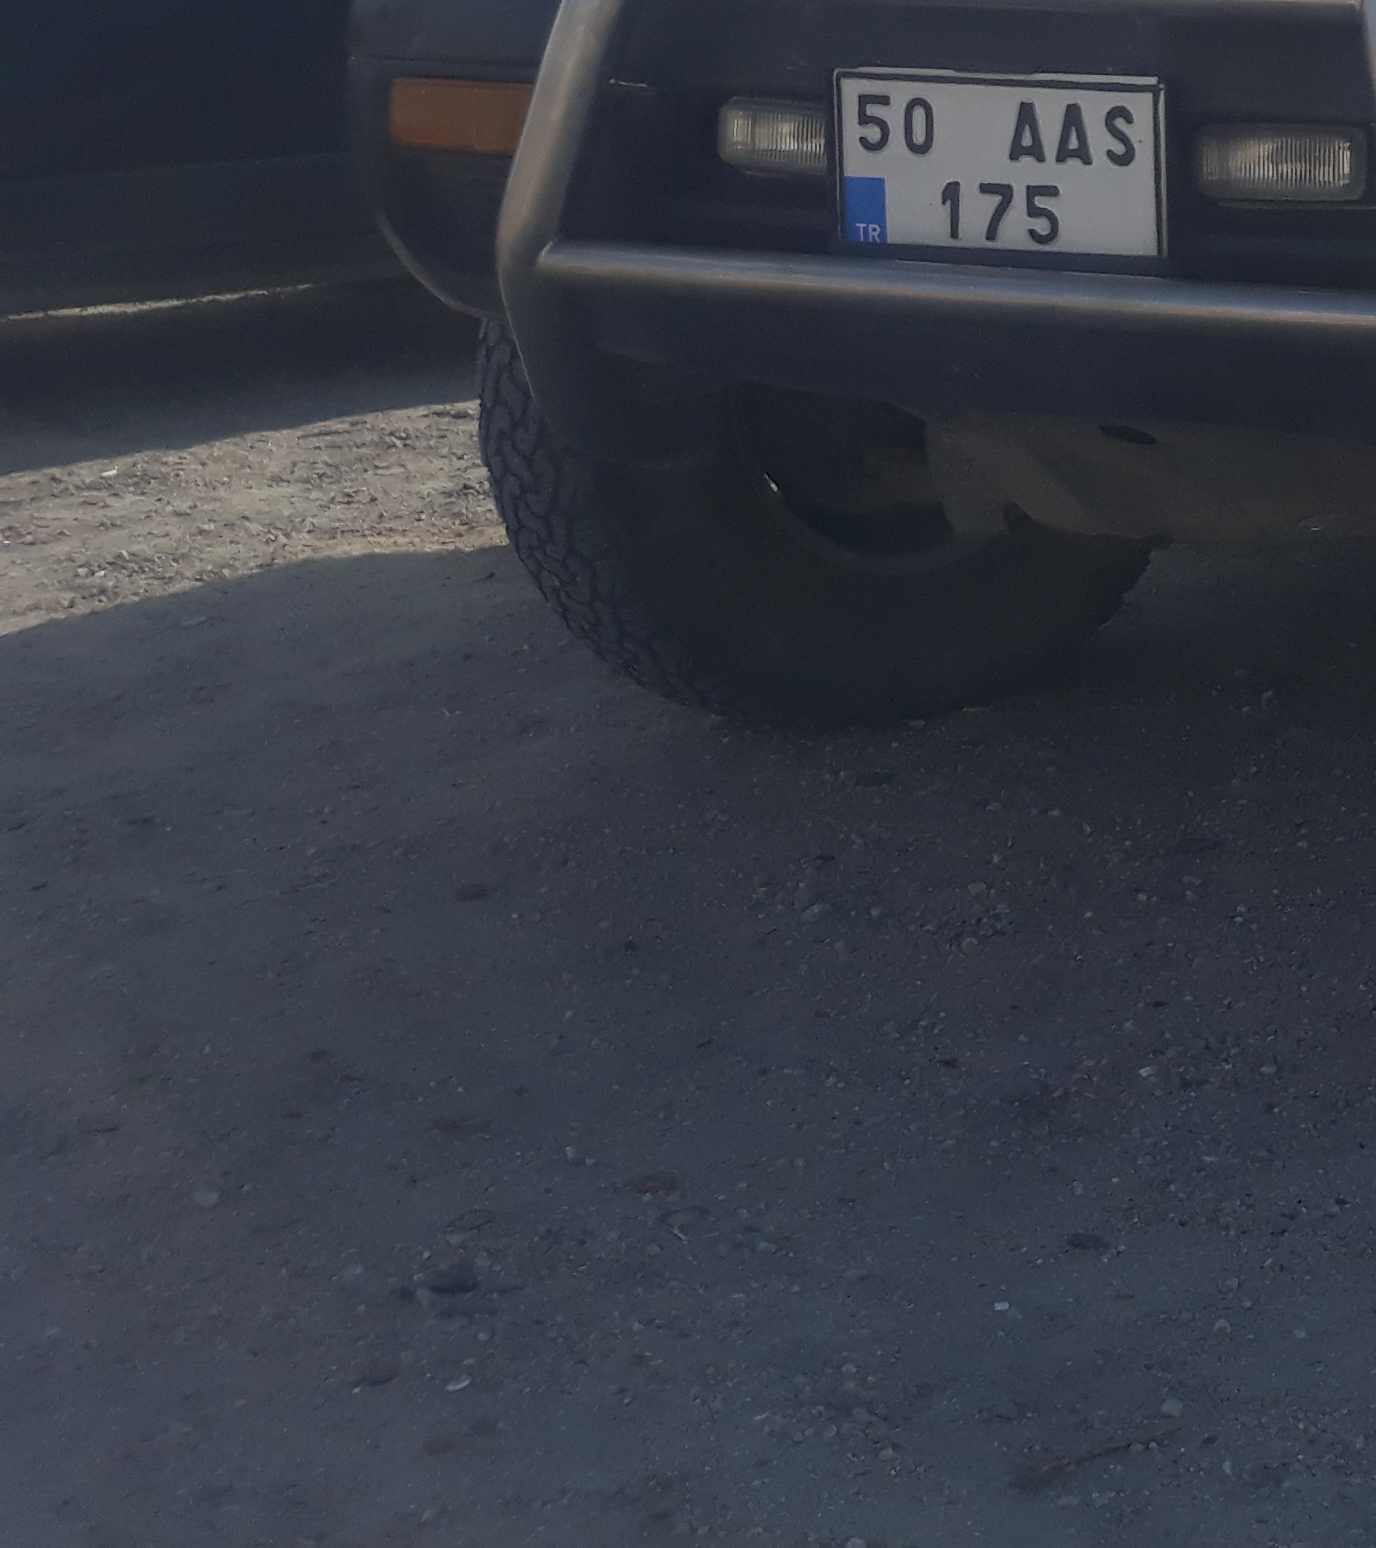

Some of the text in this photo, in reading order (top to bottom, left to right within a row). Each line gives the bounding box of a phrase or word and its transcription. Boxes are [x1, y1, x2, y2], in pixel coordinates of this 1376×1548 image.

[857, 93, 1137, 167] 50 AAS
[855, 222, 882, 242] TR
[940, 180, 1061, 245] 175
